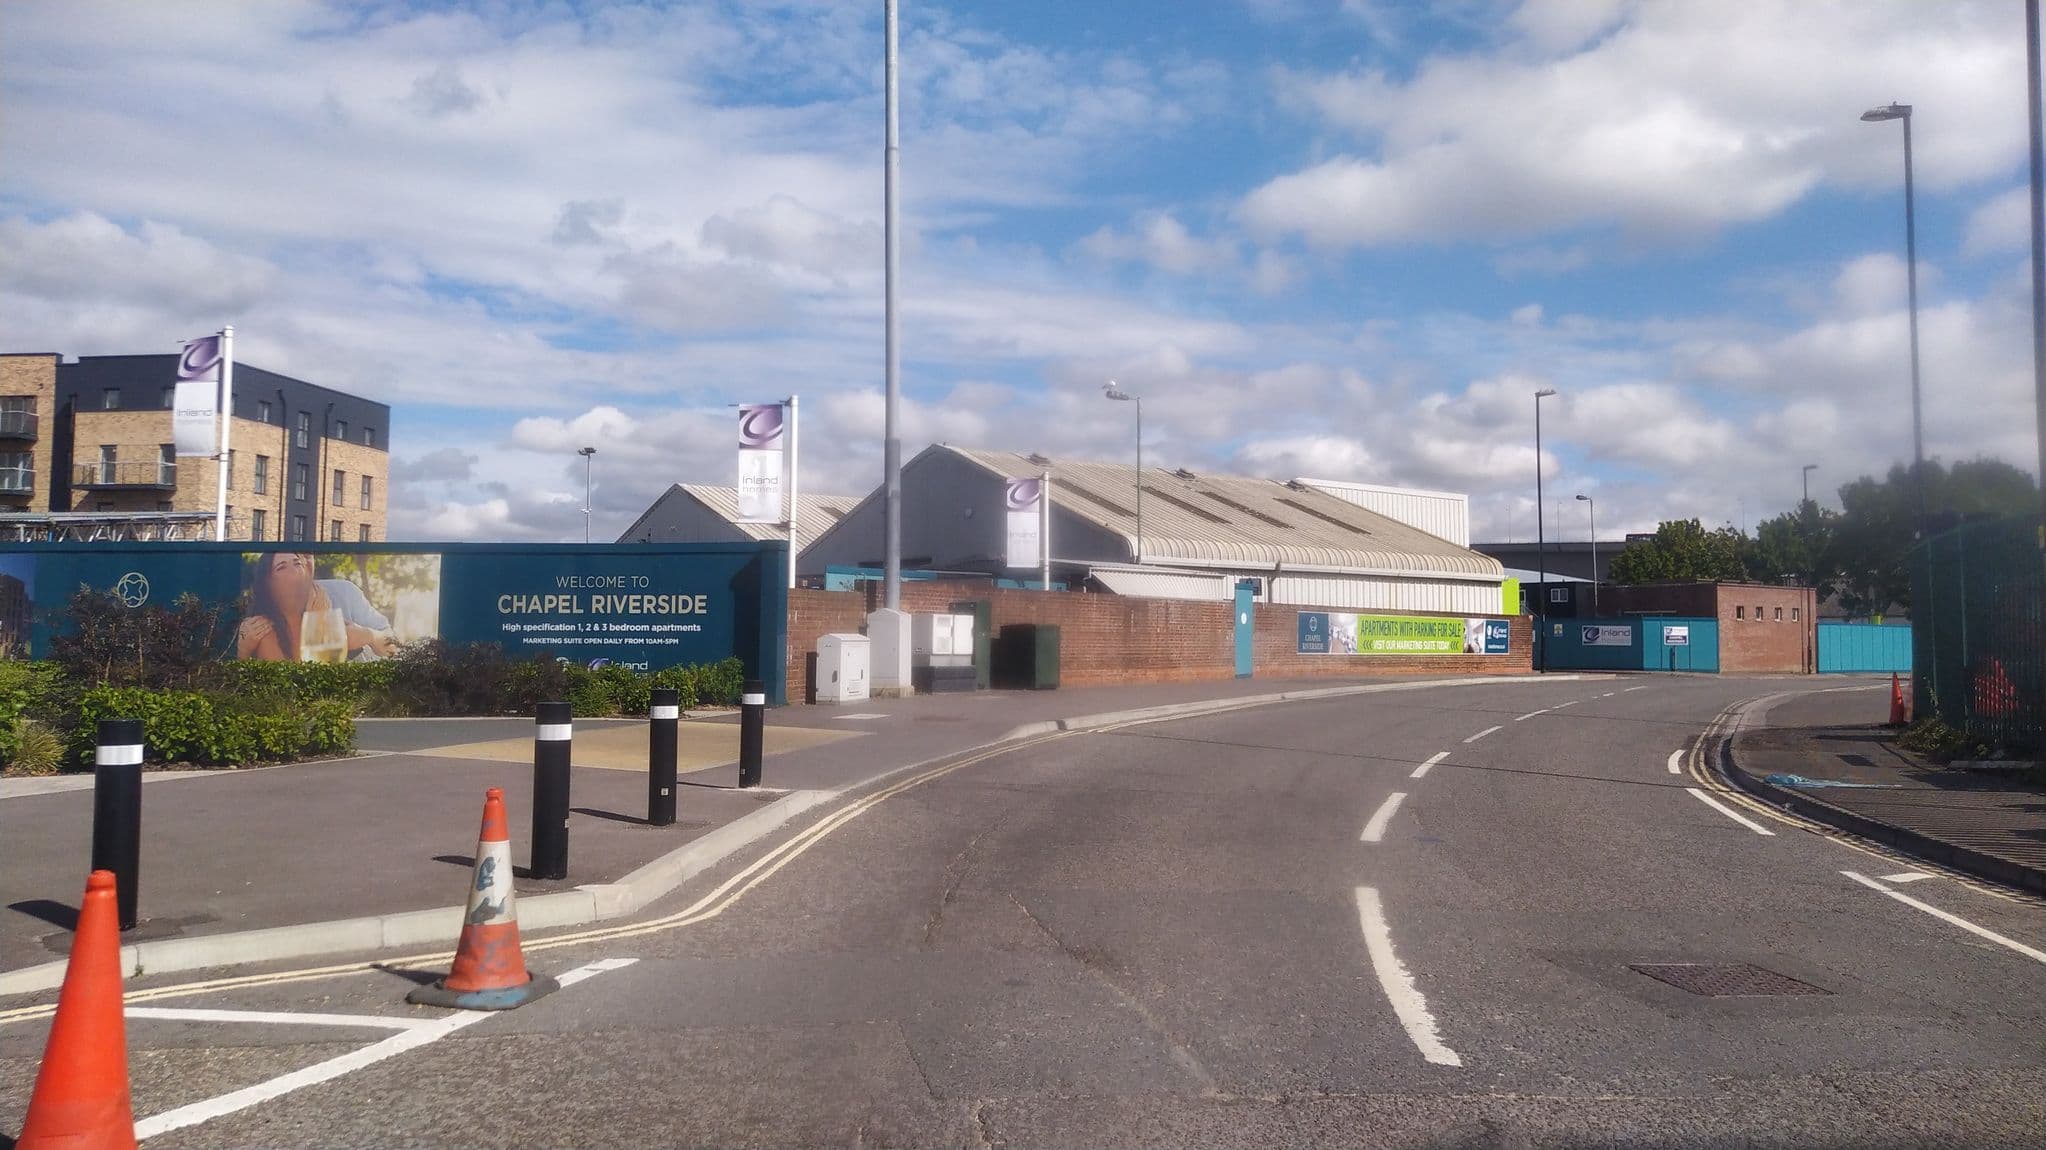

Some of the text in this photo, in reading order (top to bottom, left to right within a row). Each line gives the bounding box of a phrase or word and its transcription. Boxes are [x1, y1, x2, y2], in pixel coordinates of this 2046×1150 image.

[742, 475, 779, 485] Inland
[555, 576, 650, 588] WELCOME TO
[497, 594, 708, 614] CHAPEL RIVERSIDE
[502, 623, 701, 633] High specification 1, 2 & 3 bedroom apartments
[1361, 619, 1461, 637] APARTMENTS WITH PARKING FOR SALE
[1601, 628, 1630, 636] Inland
